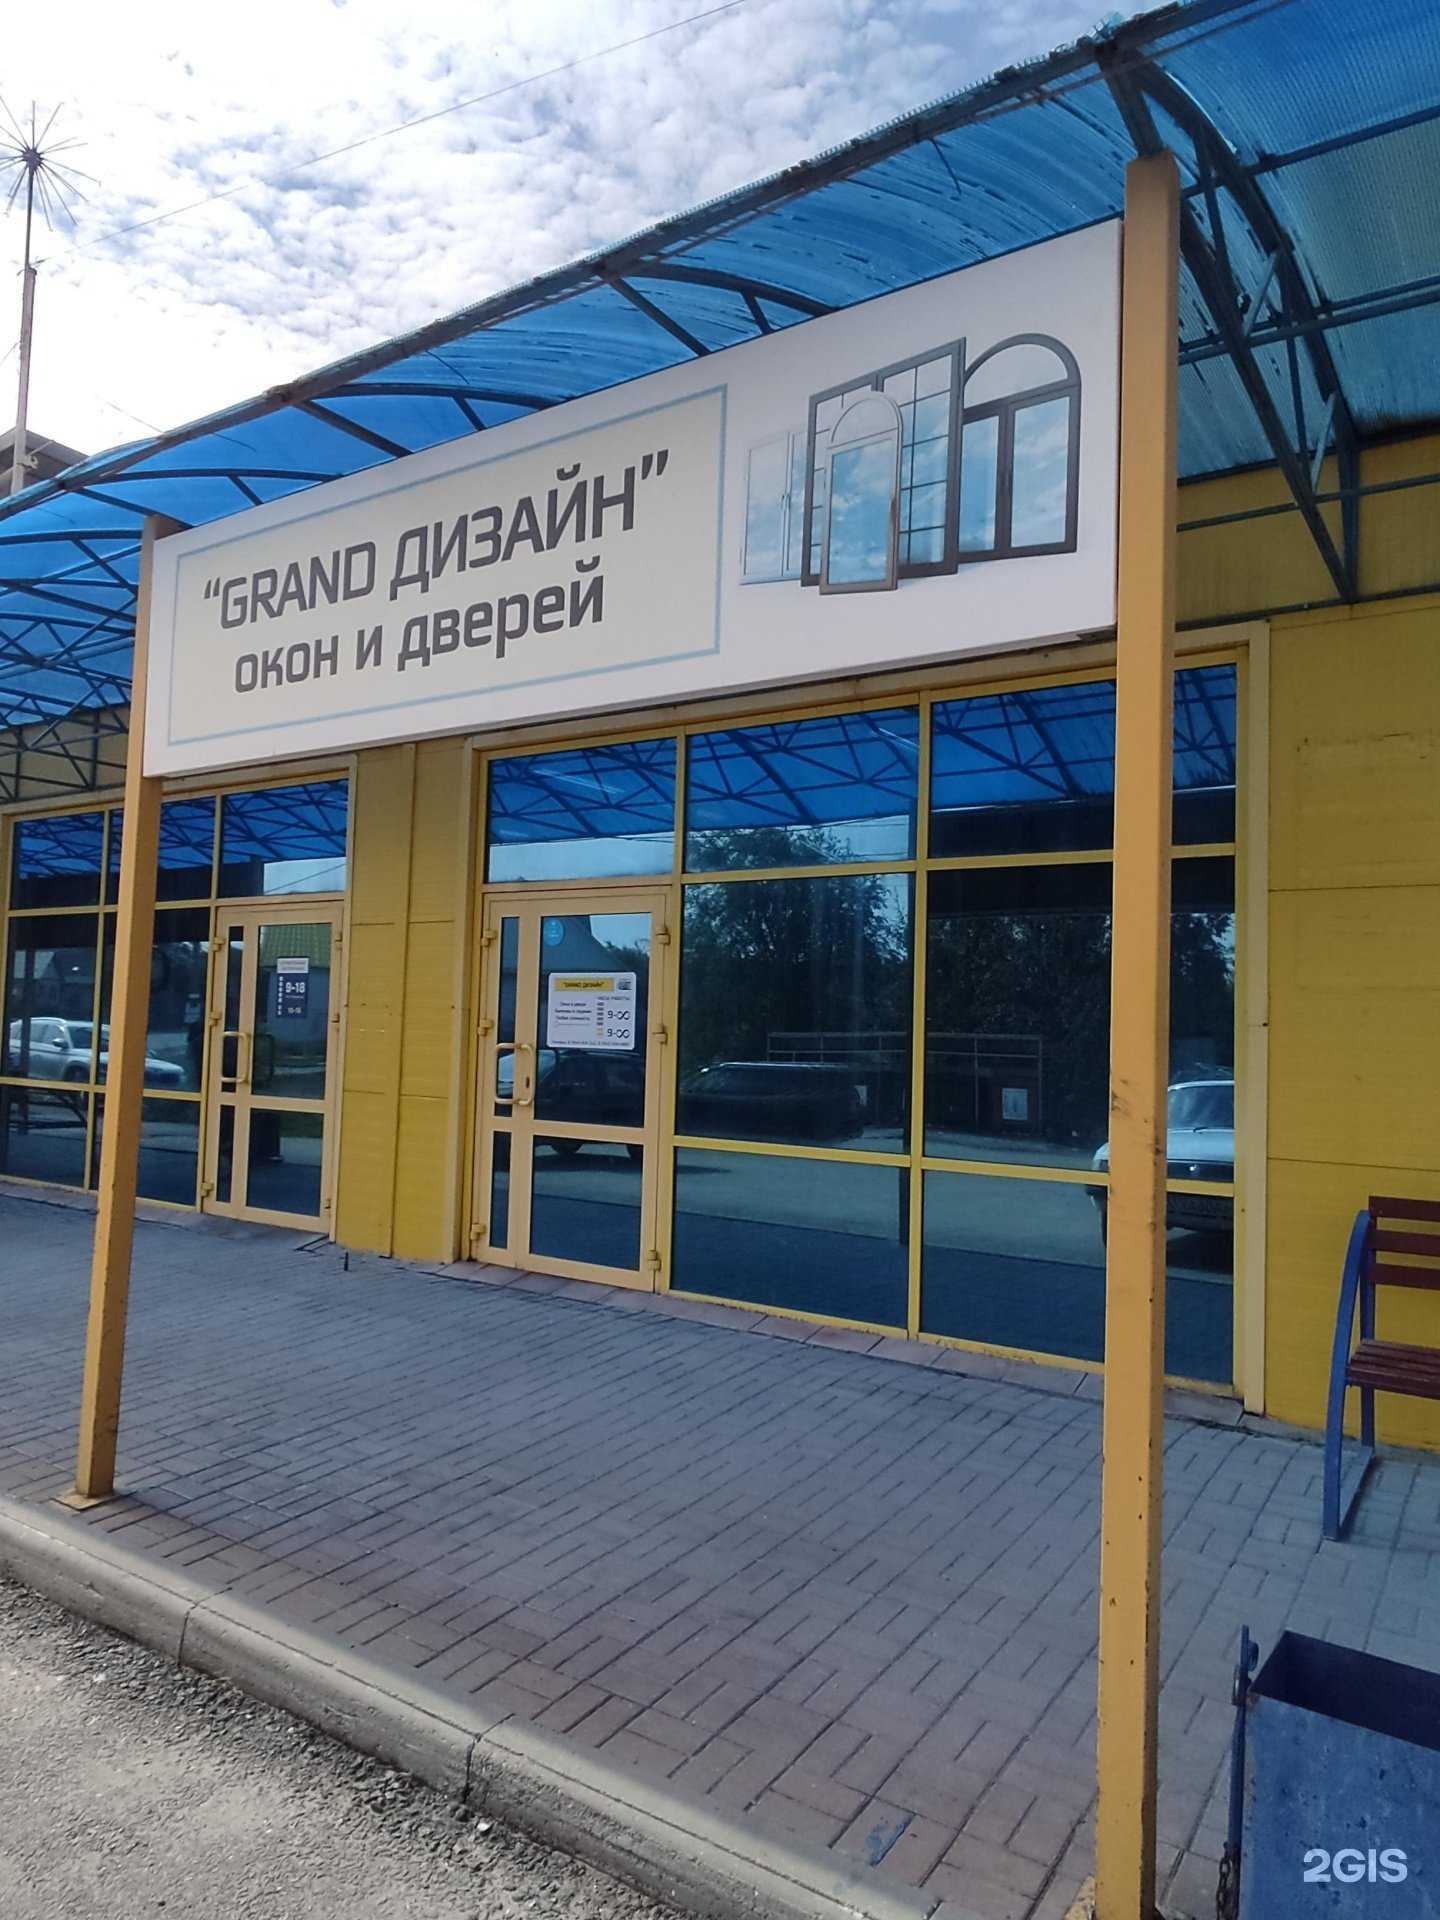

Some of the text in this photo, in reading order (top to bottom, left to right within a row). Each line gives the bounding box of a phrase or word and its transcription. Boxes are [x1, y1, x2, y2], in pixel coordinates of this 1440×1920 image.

[235, 555, 604, 693] окон и дверей
